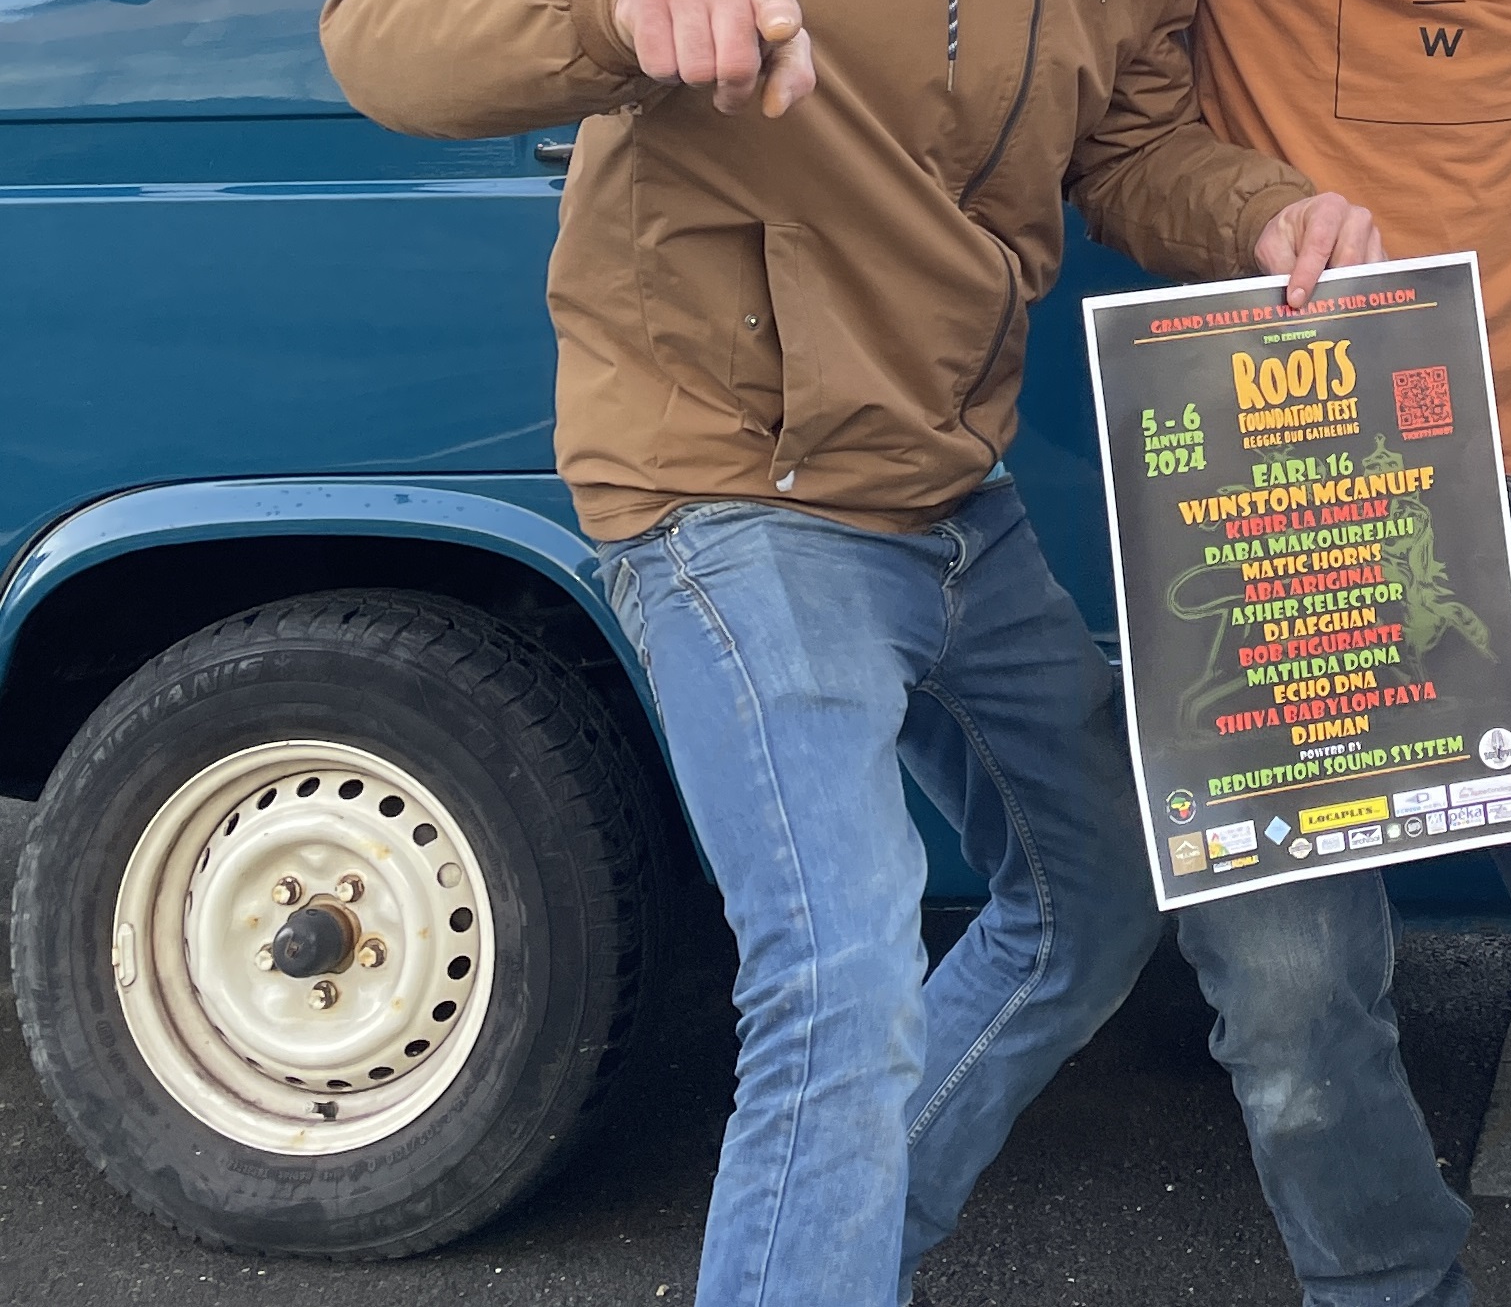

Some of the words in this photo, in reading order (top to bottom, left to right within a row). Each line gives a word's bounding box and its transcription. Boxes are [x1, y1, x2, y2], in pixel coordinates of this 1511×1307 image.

[1150, 316, 1203, 334] GRAND
[1206, 310, 1249, 327] SALLE
[1253, 307, 1273, 322] DE
[1338, 295, 1366, 311] SUR
[1369, 289, 1415, 307] OLLON
[1281, 330, 1317, 342] EDITION
[1232, 340, 1357, 410] ROOTS
[1142, 409, 1158, 436] 5
[1183, 403, 1200, 430] 6
[1327, 397, 1358, 422] FEST
[1145, 431, 1204, 451] JANVIER
[1243, 432, 1282, 449] REGGAE
[1284, 429, 1304, 443] DUB
[1306, 422, 1360, 440] GATHERING
[1145, 446, 1207, 477] 2024
[1252, 457, 1322, 488] EARL
[1326, 452, 1354, 477] 16
[1178, 484, 1308, 525] WINSTON
[1312, 466, 1435, 506] MCANUFF
[1226, 514, 1287, 539] KIBIR
[1292, 509, 1316, 530] LA
[1321, 498, 1389, 526] AMLAK
[1205, 540, 1264, 566] DABA
[1268, 517, 1414, 556] MAKOUREJAH
[1242, 553, 1309, 582] MATIC
[1311, 543, 1382, 570] HORNS
[1245, 579, 1286, 603] ABA
[1290, 565, 1386, 596] ARIGINAL
[1231, 598, 1299, 626] ASHER
[1303, 583, 1403, 615] SELECTOR
[1263, 620, 1289, 642] DJ
[1293, 606, 1377, 637] AFGHAN
[1238, 643, 1283, 668] BOB
[1287, 624, 1403, 659] FIGURANTE
[1247, 655, 1340, 687] MATILDA
[1343, 646, 1400, 673] DONA
[1274, 677, 1331, 704] ECHO
[1334, 670, 1377, 694] DNA
[1215, 708, 1281, 736] SHIVA
[1283, 690, 1380, 724] BABYLON
[1384, 682, 1437, 707] FAYA
[1291, 715, 1370, 746] DJIMAN
[1348, 741, 1362, 754] BY
[1208, 760, 1321, 797] REDUBTION
[1323, 749, 1387, 776] SOUND
[1391, 735, 1464, 763] SYSTEM
[1449, 806, 1482, 826] péka
